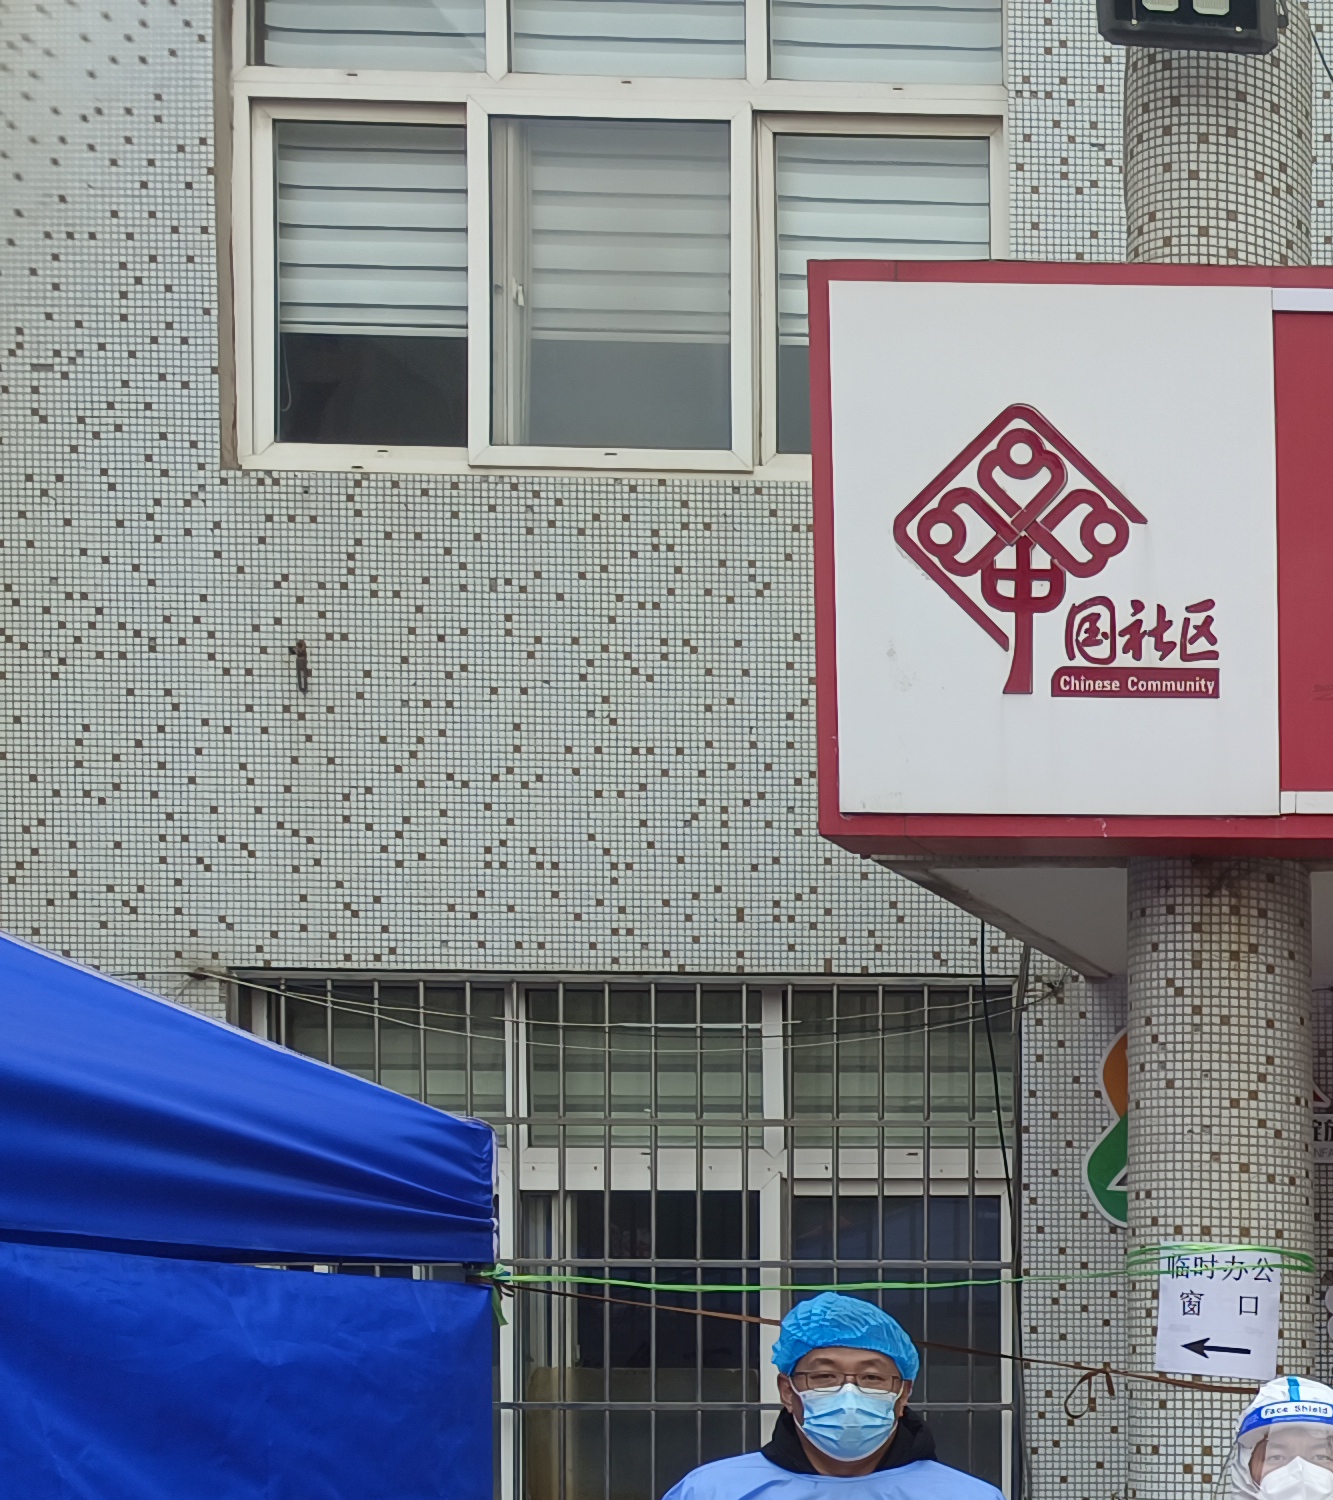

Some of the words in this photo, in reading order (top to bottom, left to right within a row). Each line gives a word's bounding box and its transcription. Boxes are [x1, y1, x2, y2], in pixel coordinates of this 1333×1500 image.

[1057, 674, 1122, 695] Chinese
[1126, 674, 1216, 699] Community
[1166, 1253, 1276, 1284] 临时办公
[1178, 1289, 1260, 1318] 窗口
[1264, 1406, 1289, 1416] Face
[1294, 1404, 1328, 1415] Shield
